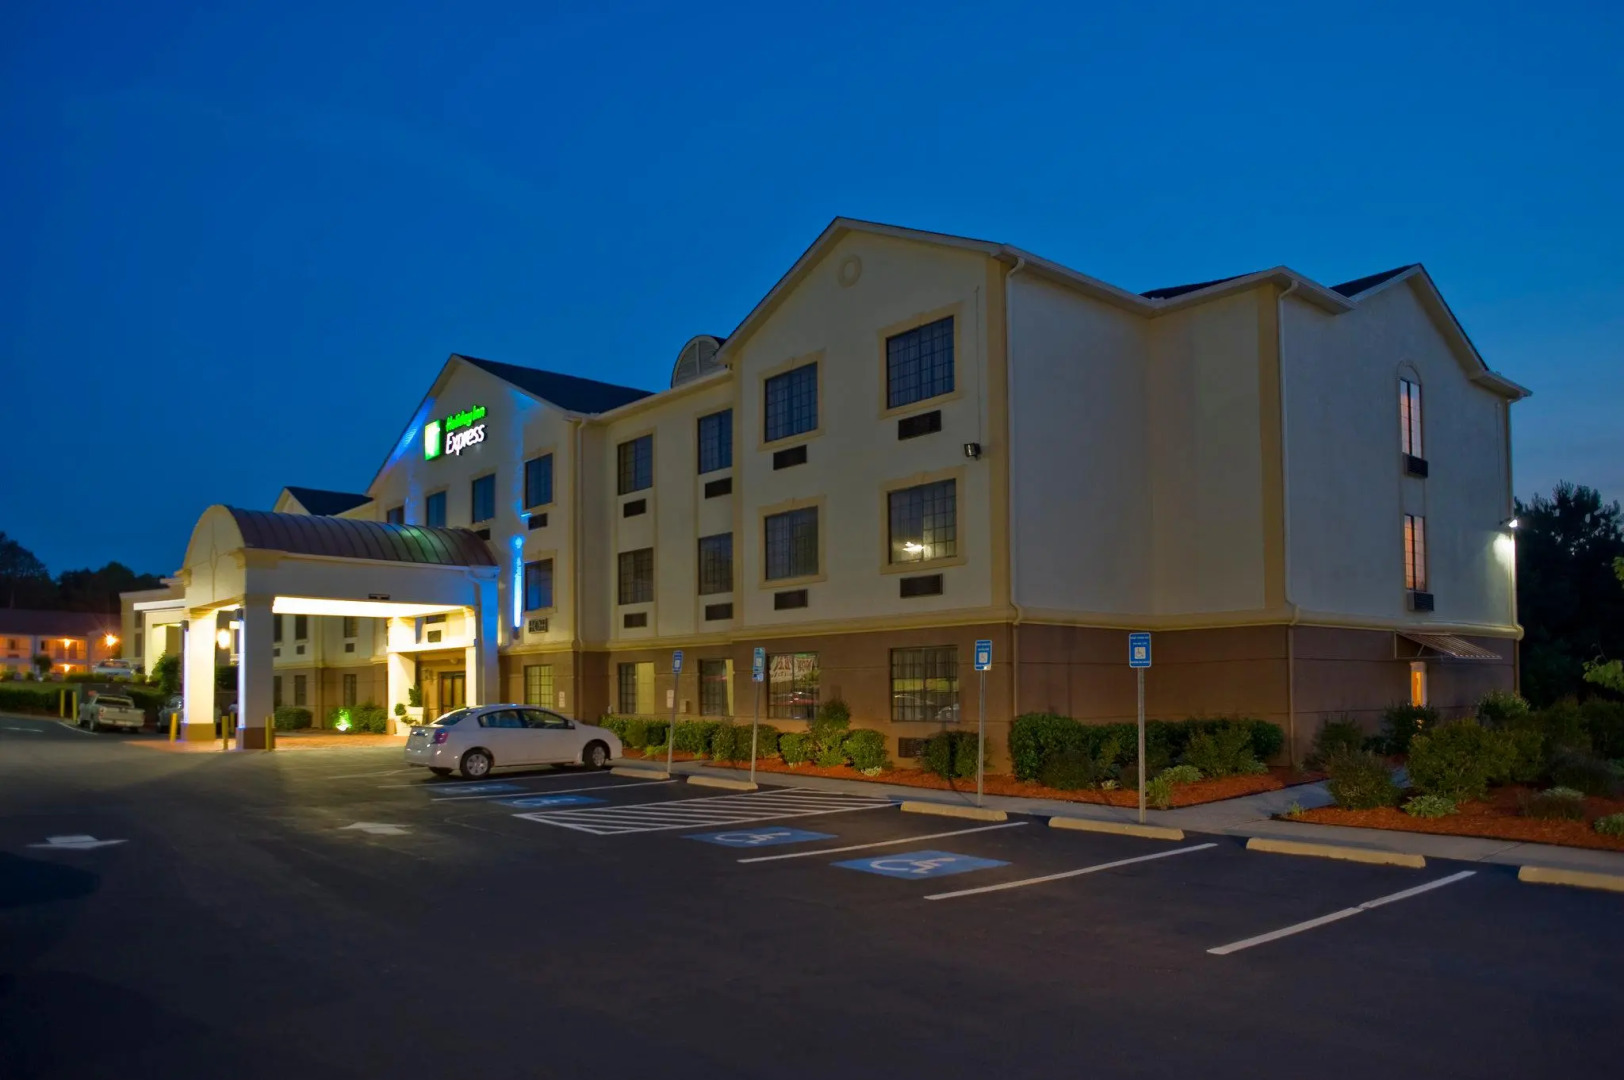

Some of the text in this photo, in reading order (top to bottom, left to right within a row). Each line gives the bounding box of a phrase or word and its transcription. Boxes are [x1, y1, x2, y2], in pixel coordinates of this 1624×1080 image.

[446, 404, 486, 432] Holiday Inn
[445, 424, 486, 456] Express
